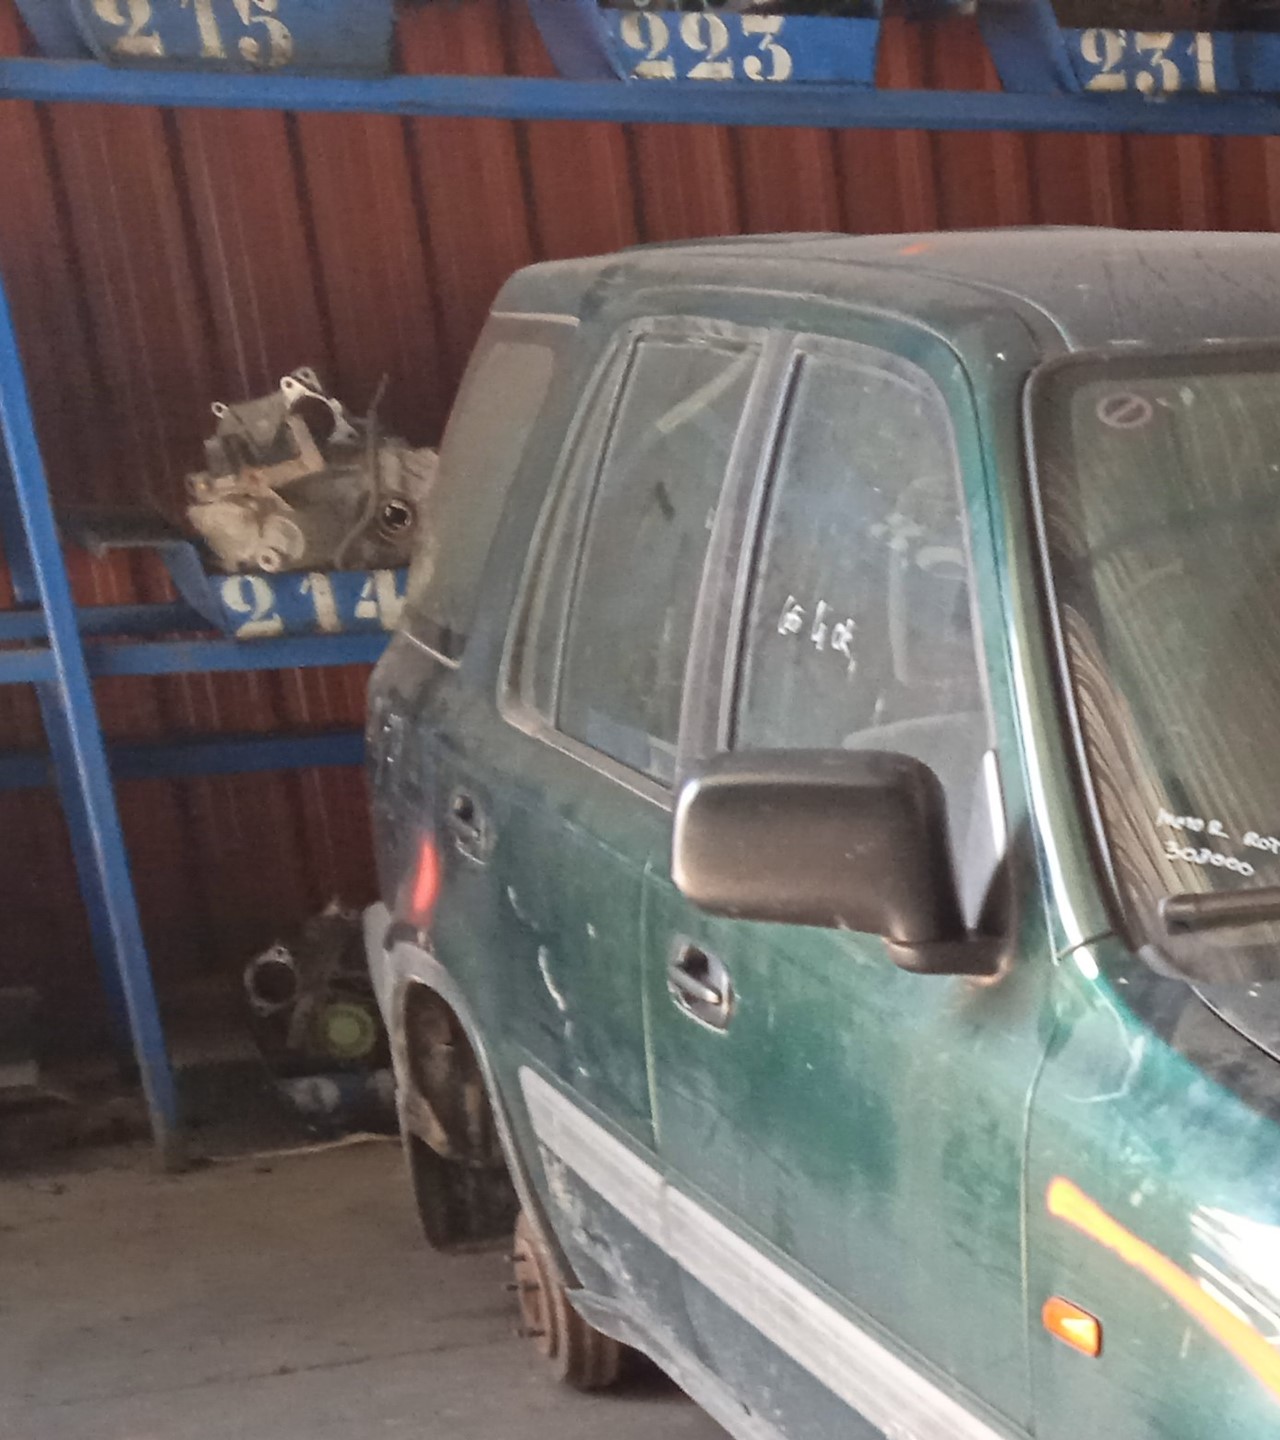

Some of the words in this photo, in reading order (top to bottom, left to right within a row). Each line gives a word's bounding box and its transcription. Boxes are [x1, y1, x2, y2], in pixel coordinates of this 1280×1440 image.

[94, 0, 295, 68] 215
[621, 11, 792, 81] 223
[1080, 28, 1216, 93] 231
[221, 569, 405, 639] 214
